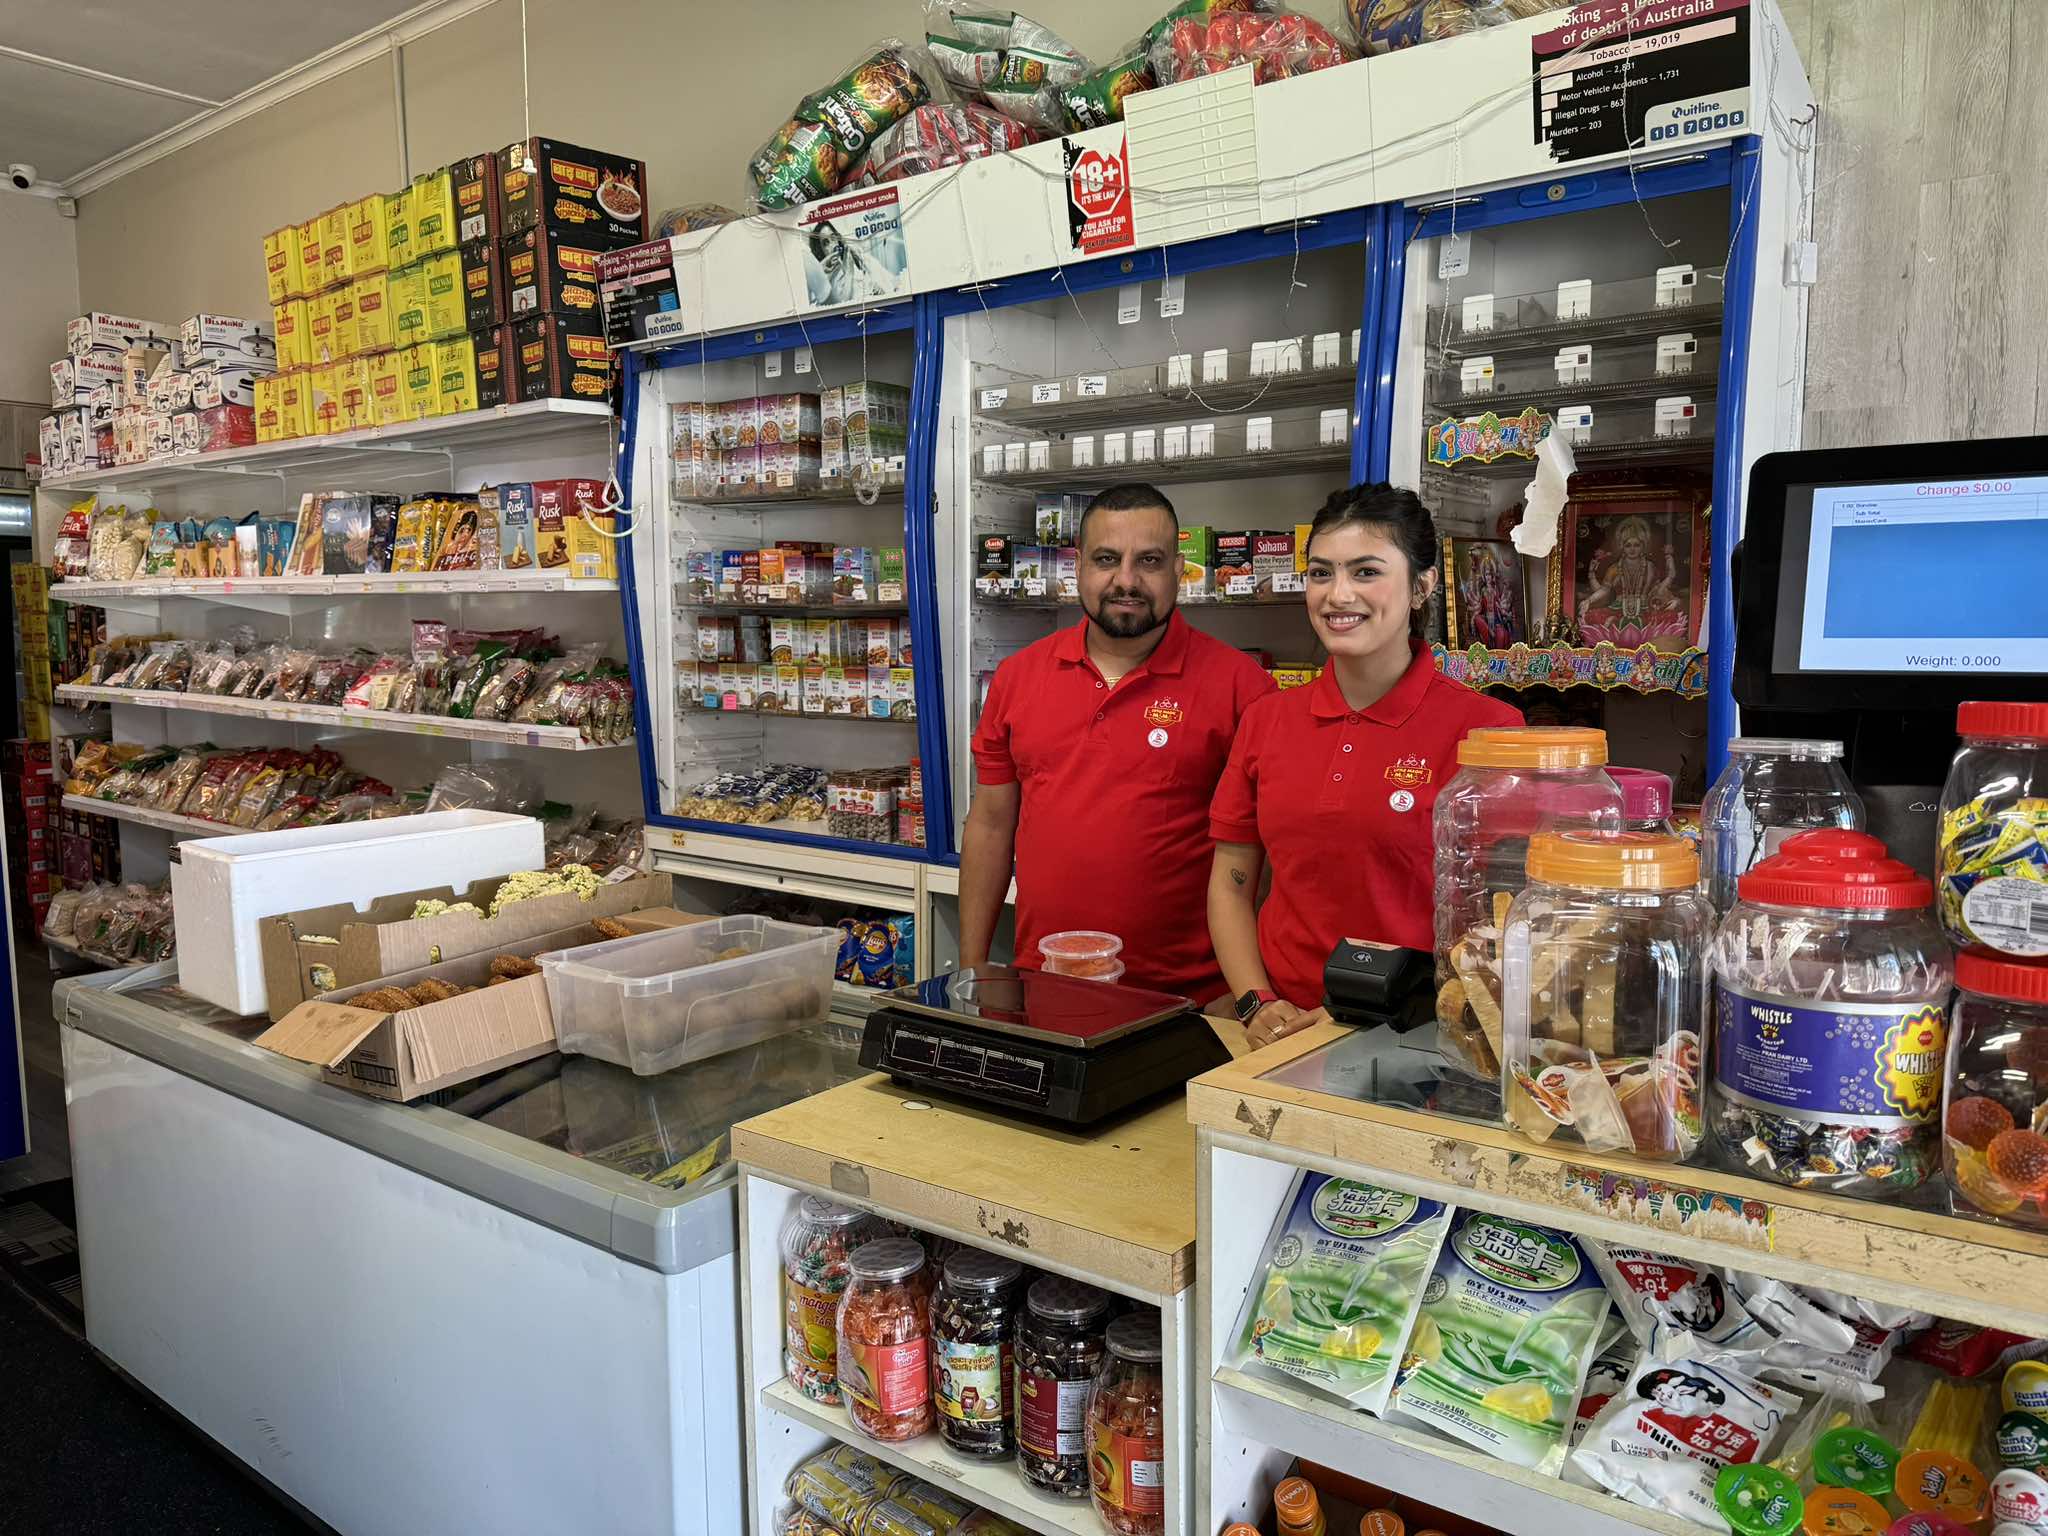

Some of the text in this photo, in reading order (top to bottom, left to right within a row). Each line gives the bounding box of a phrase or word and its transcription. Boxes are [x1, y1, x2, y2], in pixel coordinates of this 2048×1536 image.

[1561, 8, 1600, 27] oking
[1562, 31, 1577, 45] of
[1580, 20, 1622, 41] death
[1644, 0, 1715, 26] Australia
[1590, 32, 1681, 62] Tobacco 19,019
[1576, 68, 1604, 82] Alcohol
[1561, 68, 1680, 102] Motor Vehicle Accidents 1,731
[1555, 98, 1624, 121] Illegal Drugs 863
[1549, 119, 1602, 139] Murders 203
[1075, 160, 1119, 195] 18+
[822, 205, 844, 216] children
[843, 200, 865, 212] breathe
[865, 197, 878, 207] your
[878, 192, 896, 202] smoke
[1081, 190, 1115, 205] IT'S THE LAW
[609, 223, 619, 233] 30
[1076, 215, 1126, 233] IF YOU ASK FOR
[1081, 224, 1121, 239] CIGARETTES
[651, 244, 667, 254] cause
[613, 264, 628, 275] death
[636, 257, 661, 269] Australia
[575, 489, 594, 499] Rusk
[1916, 482, 2012, 497] Change $0.00
[506, 501, 525, 514] Rusk
[539, 505, 561, 520] Rusk
[1218, 536, 1247, 547] EVEREST
[1257, 541, 1288, 553] Suhana
[1271, 557, 1292, 565] Pepper
[1906, 655, 2001, 669] Weight: 0.000
[1751, 1005, 1793, 1024] WHISTLE
[1762, 1050, 1808, 1064] PRAN DAIRY LTD
[1333, 1250, 1358, 1261] CANDY
[800, 1294, 837, 1315] mango
[1464, 1288, 1488, 1301] MILK
[1490, 1297, 1521, 1313] CANDY
[1695, 1418, 1747, 1450] 大白兔
[1627, 1443, 1648, 1452] since
[1637, 1418, 1727, 1471] White Rab
[1854, 1440, 1887, 1470] Jelly
[1921, 1465, 1946, 1498] Jelly
[1762, 1495, 1791, 1528] Jelly
